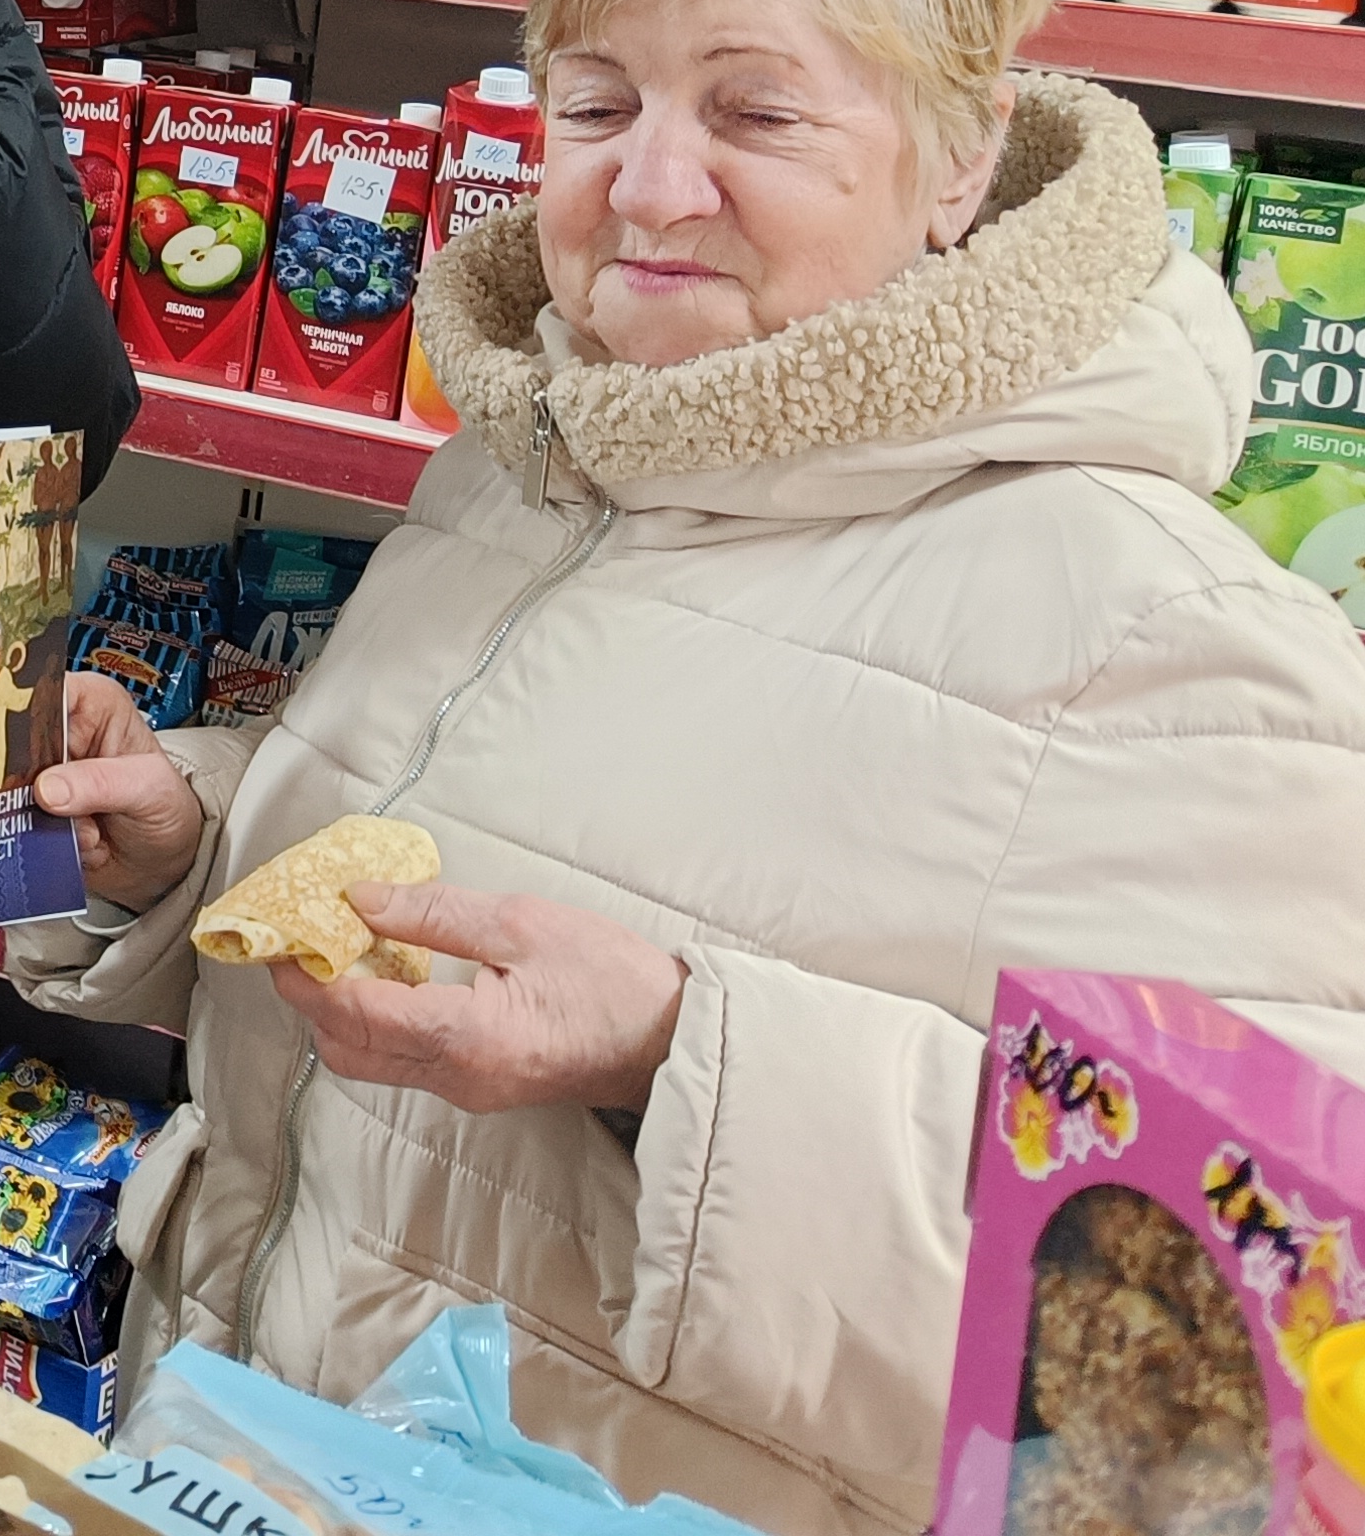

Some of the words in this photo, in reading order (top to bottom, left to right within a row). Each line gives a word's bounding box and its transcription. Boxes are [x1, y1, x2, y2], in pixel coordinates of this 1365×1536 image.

[143, 106, 273, 147] Любимый
[293, 128, 430, 171] Любимый
[1258, 203, 1300, 220] 100%
[1257, 218, 1337, 238] КАЧЕСТВО
[164, 301, 205, 320] ЯБЛОКО
[300, 323, 364, 347] ЧЕРНИЧНАЯ
[309, 338, 351, 357] ЗАБОТА
